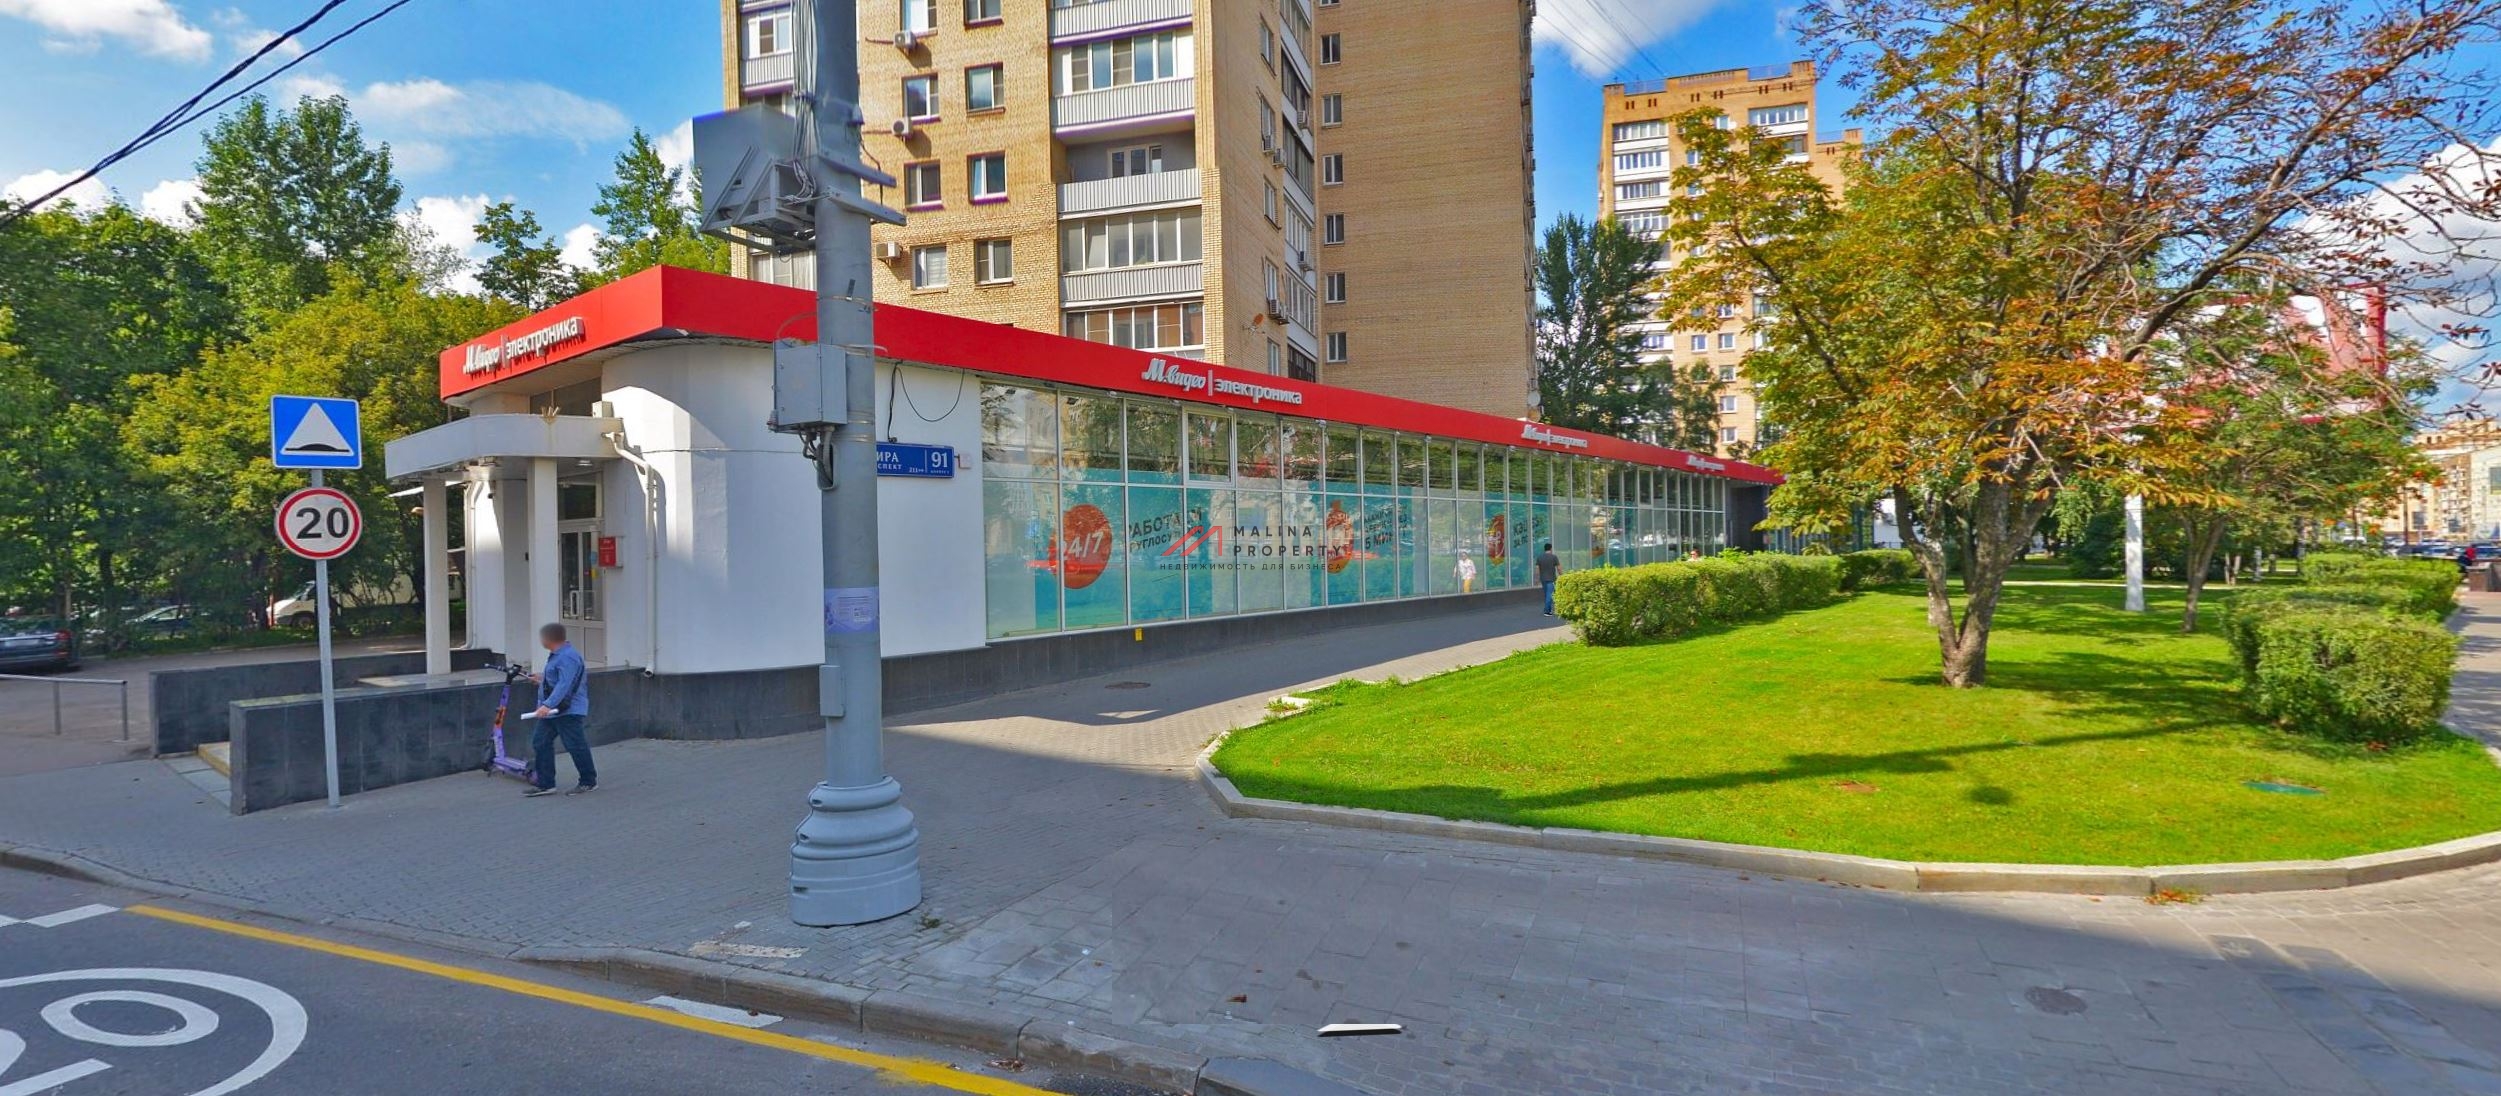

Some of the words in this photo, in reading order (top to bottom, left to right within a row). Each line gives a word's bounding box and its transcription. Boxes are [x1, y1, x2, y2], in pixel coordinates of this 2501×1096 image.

[506, 317, 582, 359] электроника
[1214, 378, 1302, 404] электроника
[876, 451, 899, 462] ИРА
[931, 451, 948, 468] 91
[296, 507, 349, 539] 20
